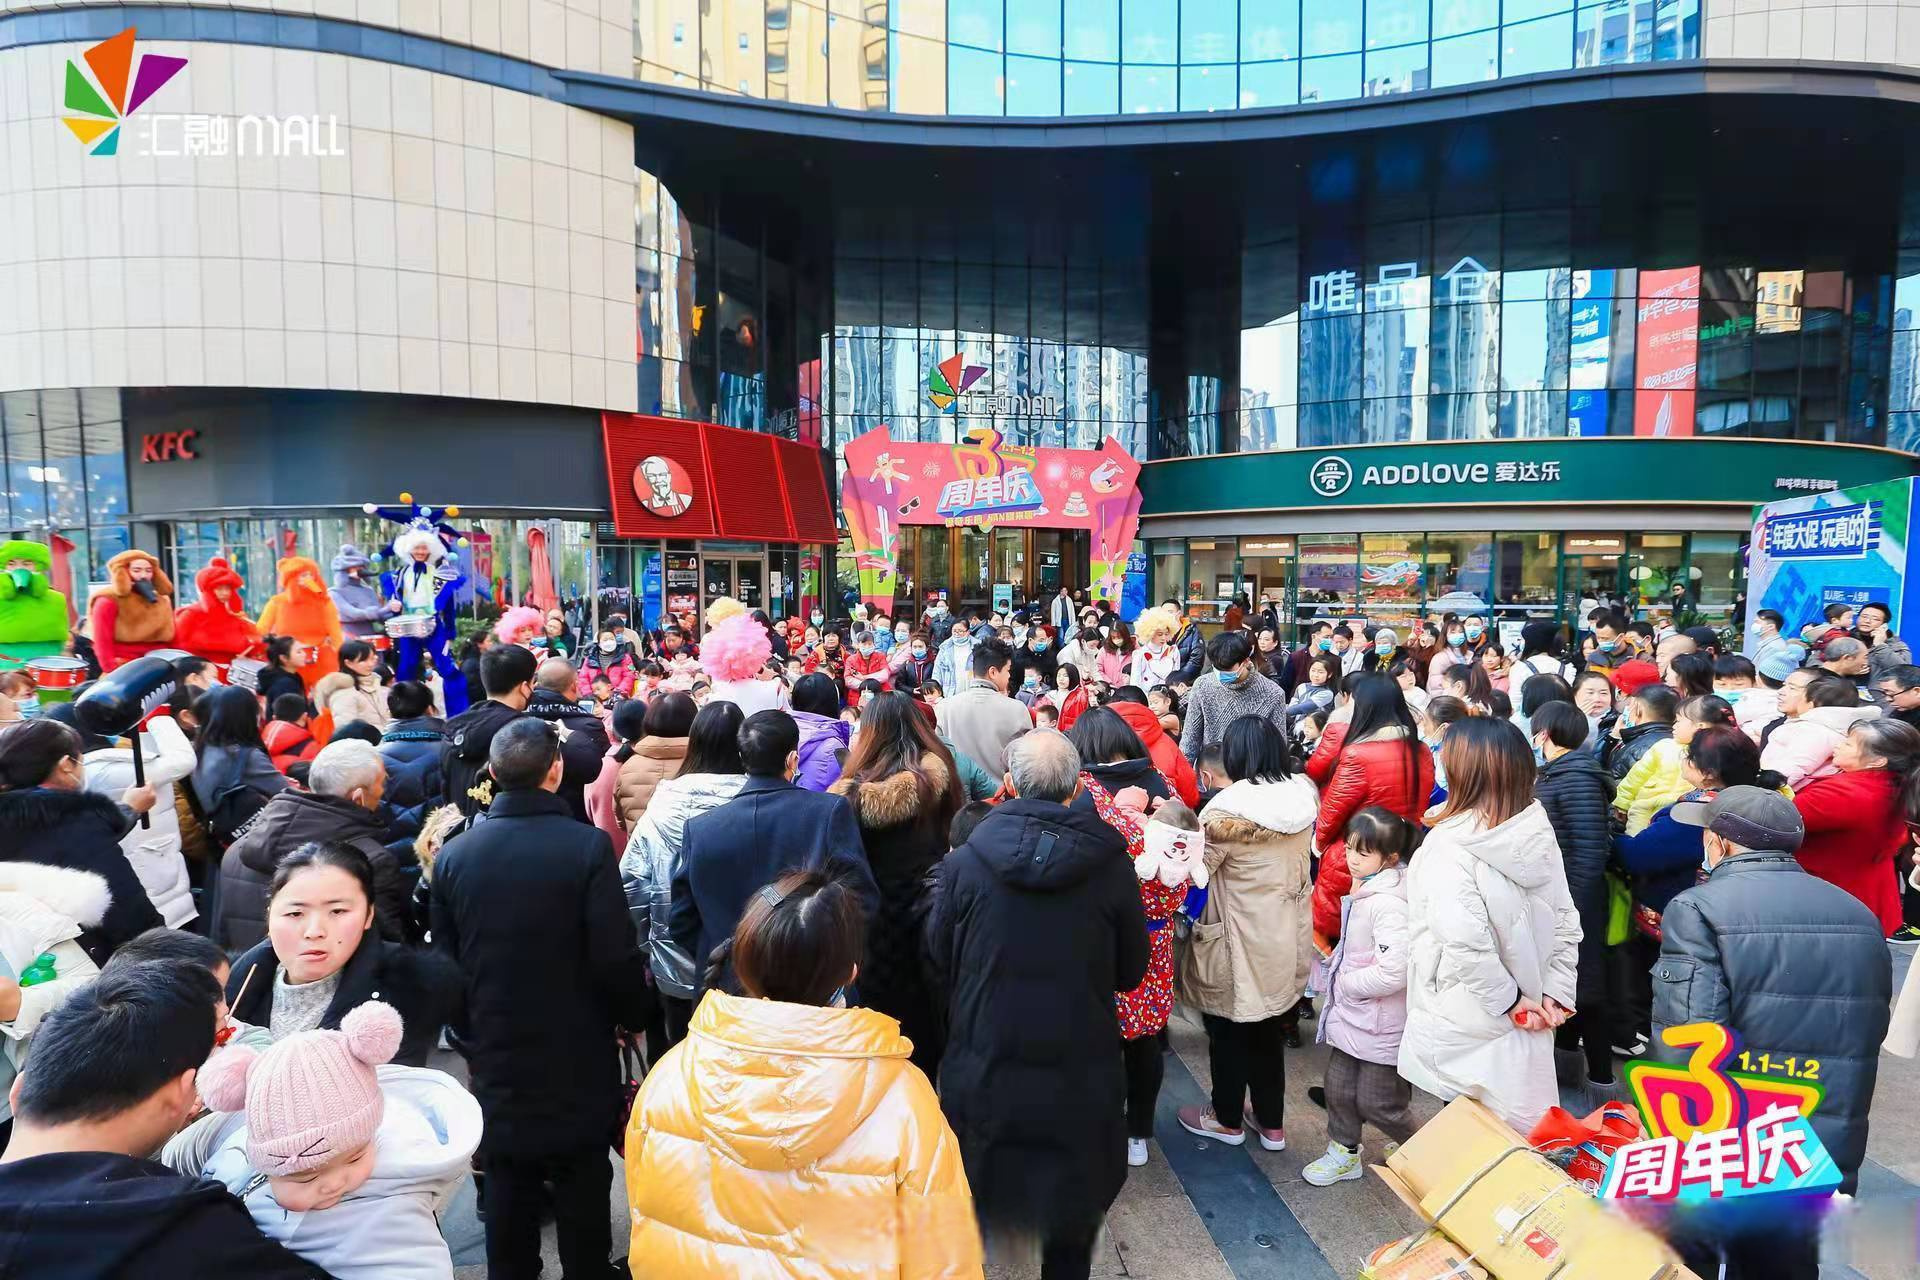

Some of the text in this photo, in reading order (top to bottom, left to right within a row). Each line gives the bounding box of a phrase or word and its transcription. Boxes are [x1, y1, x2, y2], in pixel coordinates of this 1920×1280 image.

[142, 428, 196, 462] KFC
[940, 466, 1032, 508] 周年庆
[1495, 461, 1561, 483] 爱达乐
[1773, 513, 1865, 549] 年度大促 玩真的
